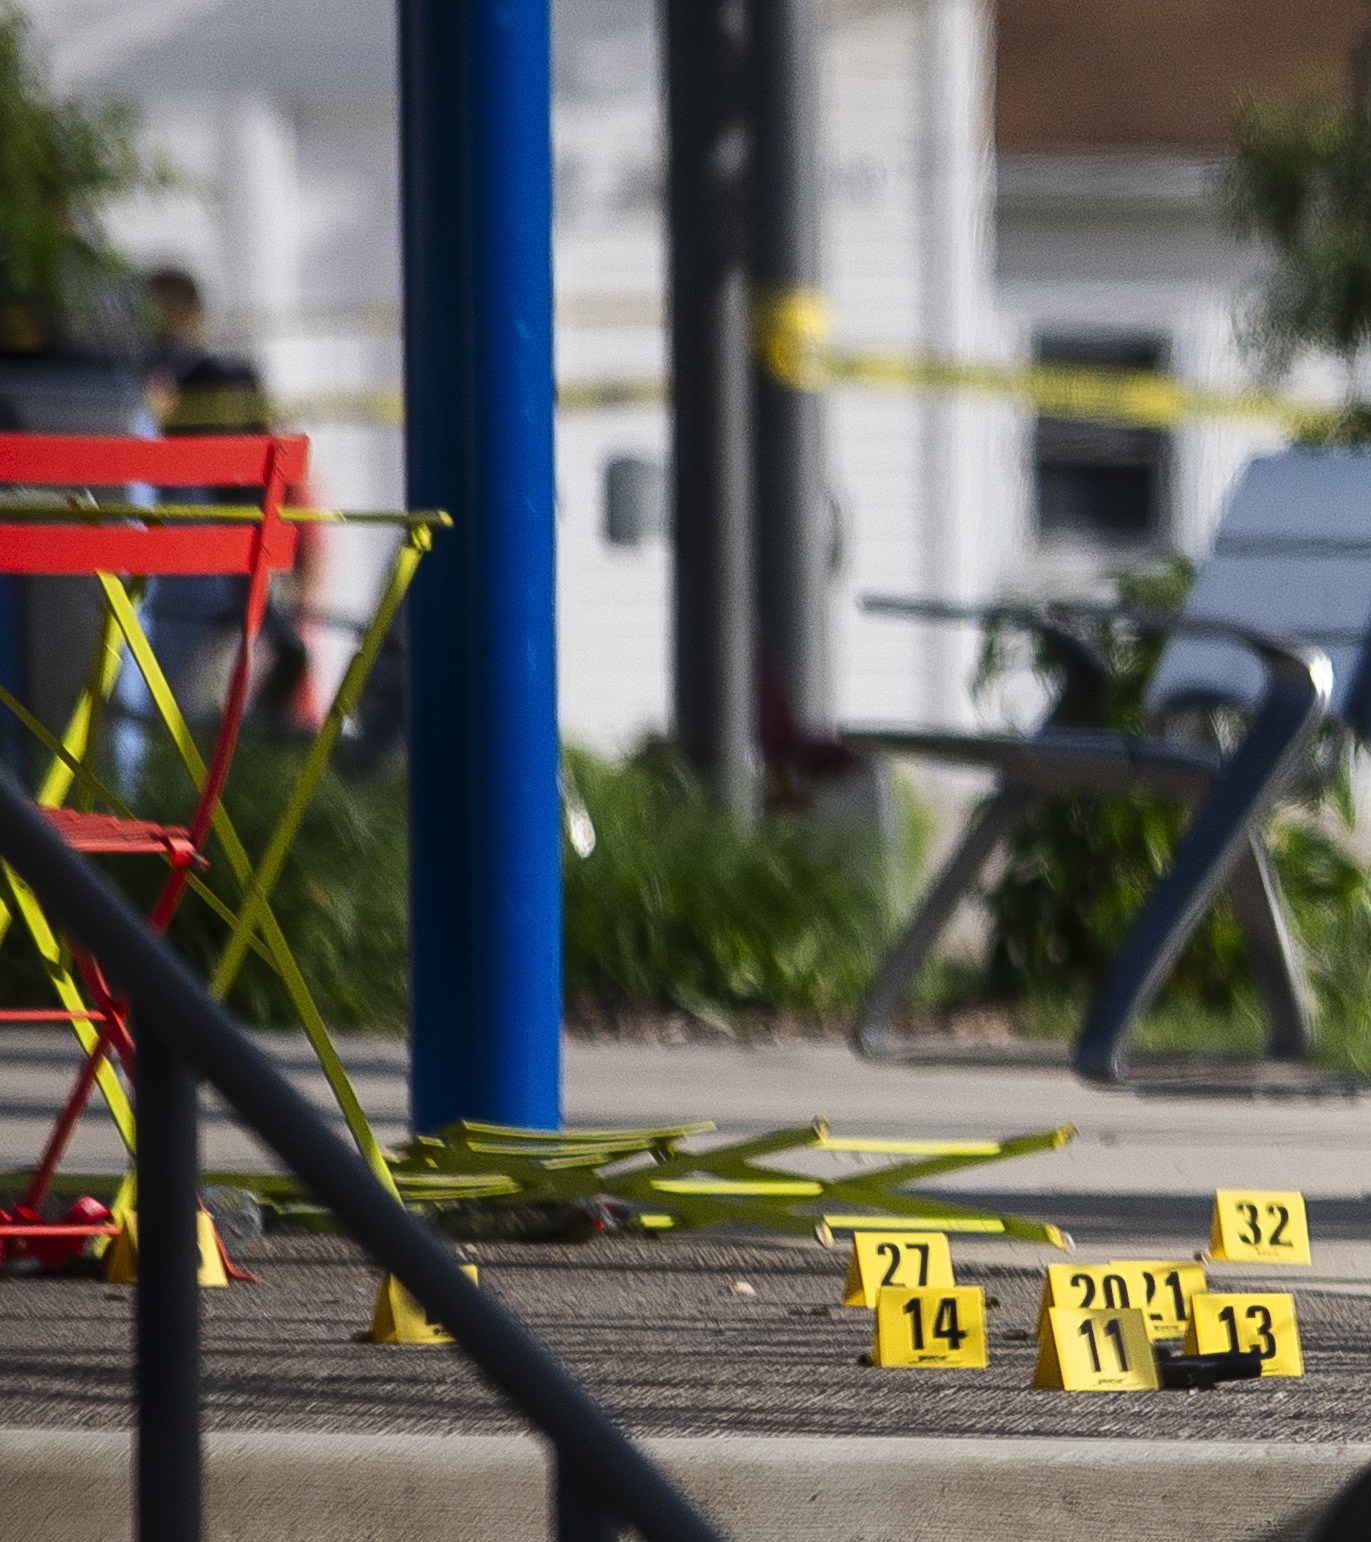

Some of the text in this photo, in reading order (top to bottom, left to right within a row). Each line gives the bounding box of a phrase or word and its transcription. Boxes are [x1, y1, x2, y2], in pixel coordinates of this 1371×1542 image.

[1236, 1203, 1293, 1248] 32
[877, 1243, 929, 1288] 27
[1071, 1273, 1130, 1309] 20
[903, 1297, 966, 1350] 14
[1078, 1318, 1129, 1373] 11
[1217, 1305, 1277, 1360] 13
